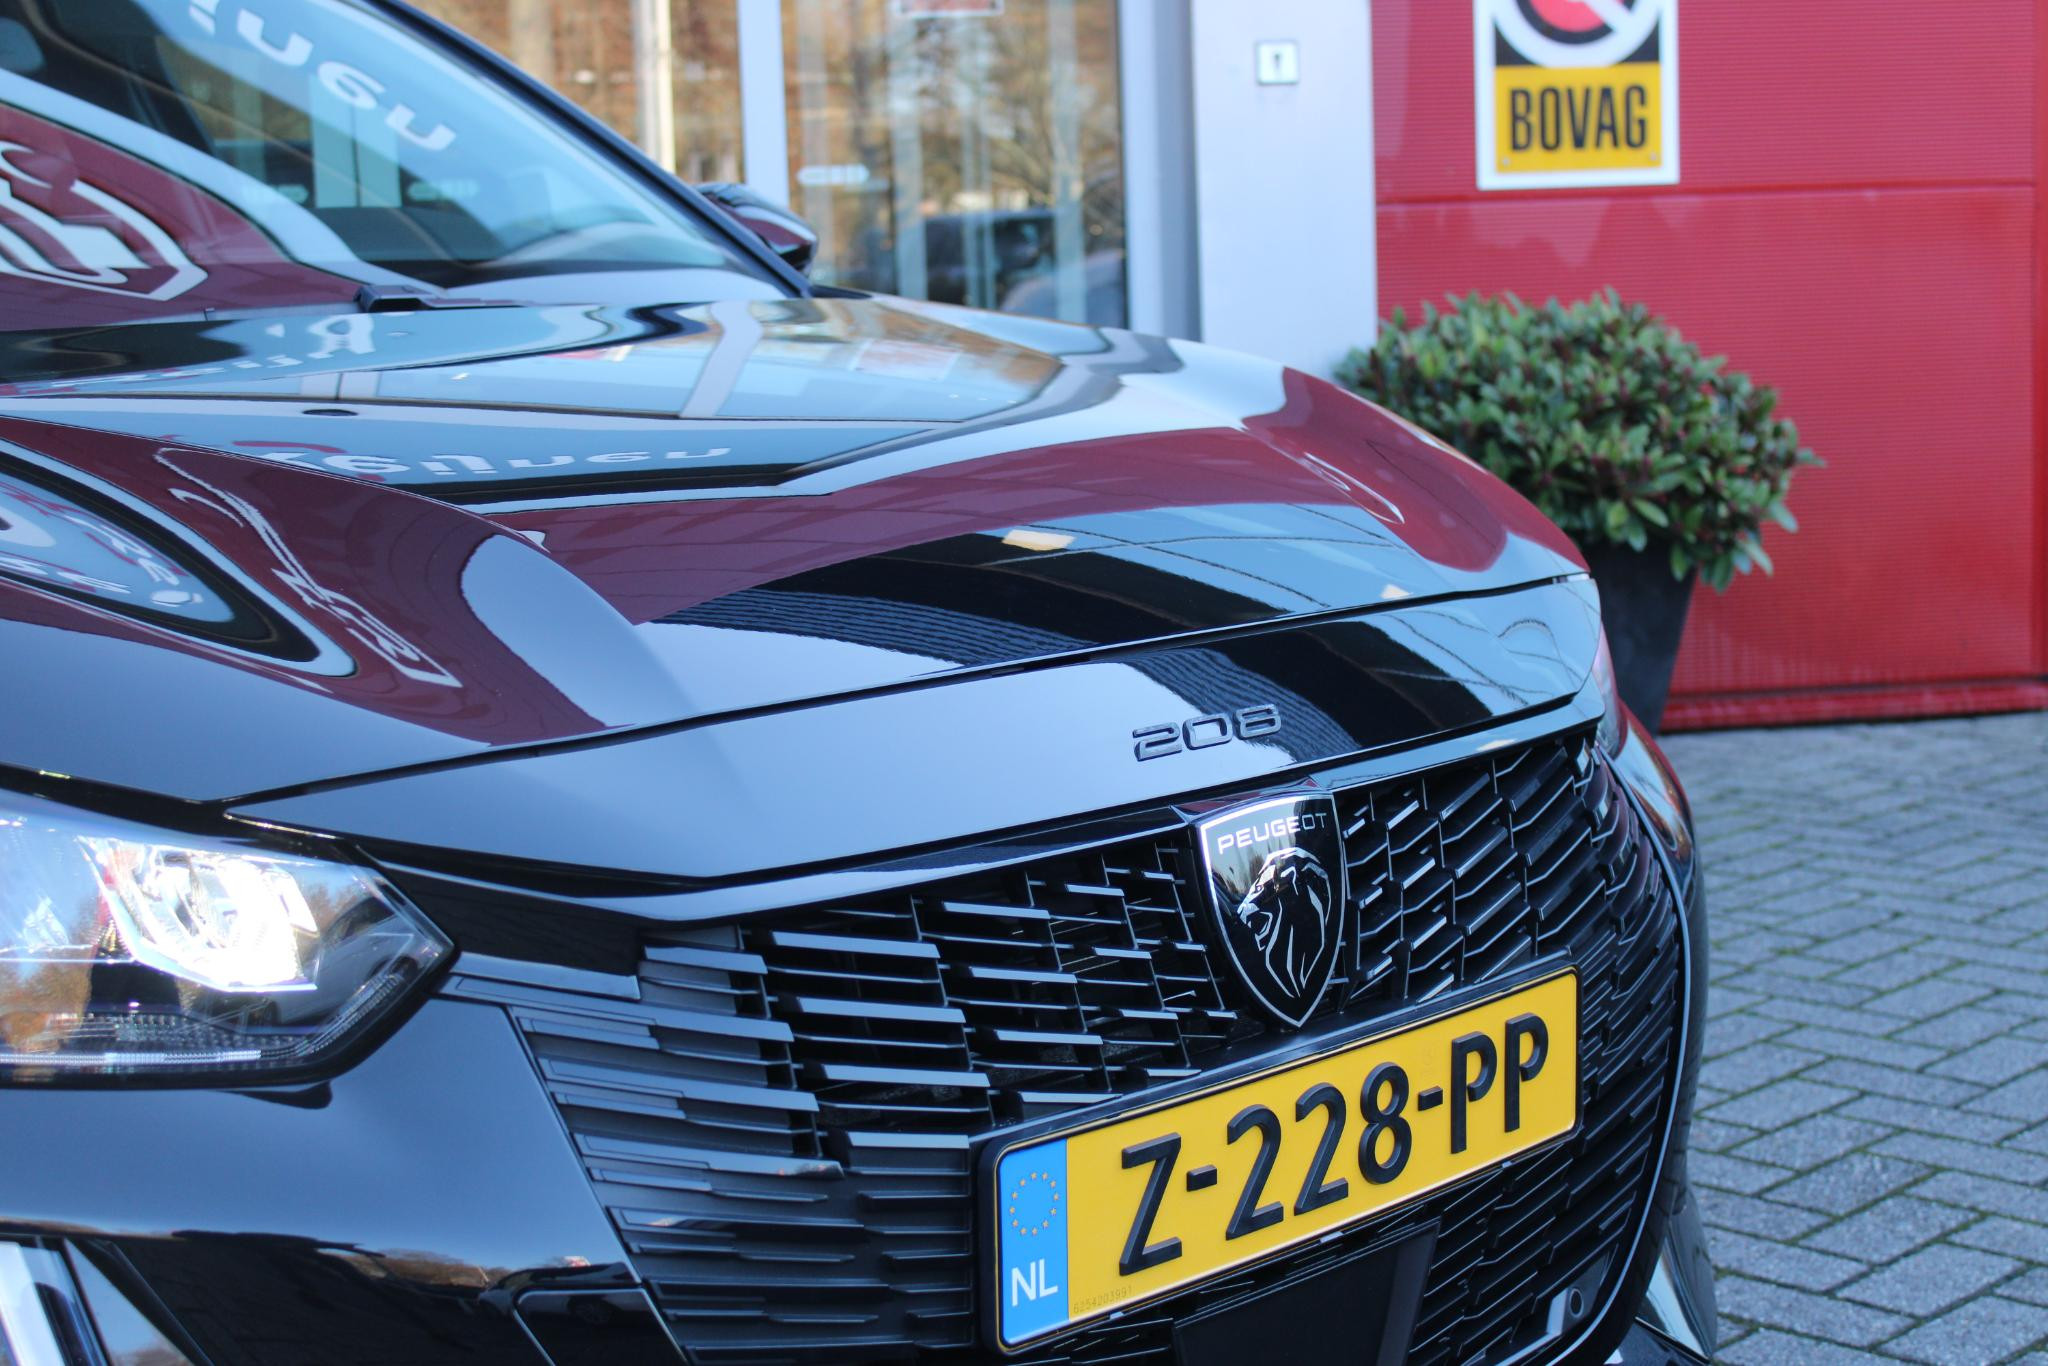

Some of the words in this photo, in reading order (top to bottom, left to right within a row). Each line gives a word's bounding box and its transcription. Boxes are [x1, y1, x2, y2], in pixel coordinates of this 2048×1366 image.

[1511, 84, 1647, 152] BOVAG
[1132, 703, 1282, 762] 208
[1217, 812, 1328, 855] PEUGEOT
[1119, 1012, 1549, 1276] Z-228-PP
[1011, 1258, 1058, 1307] NL
